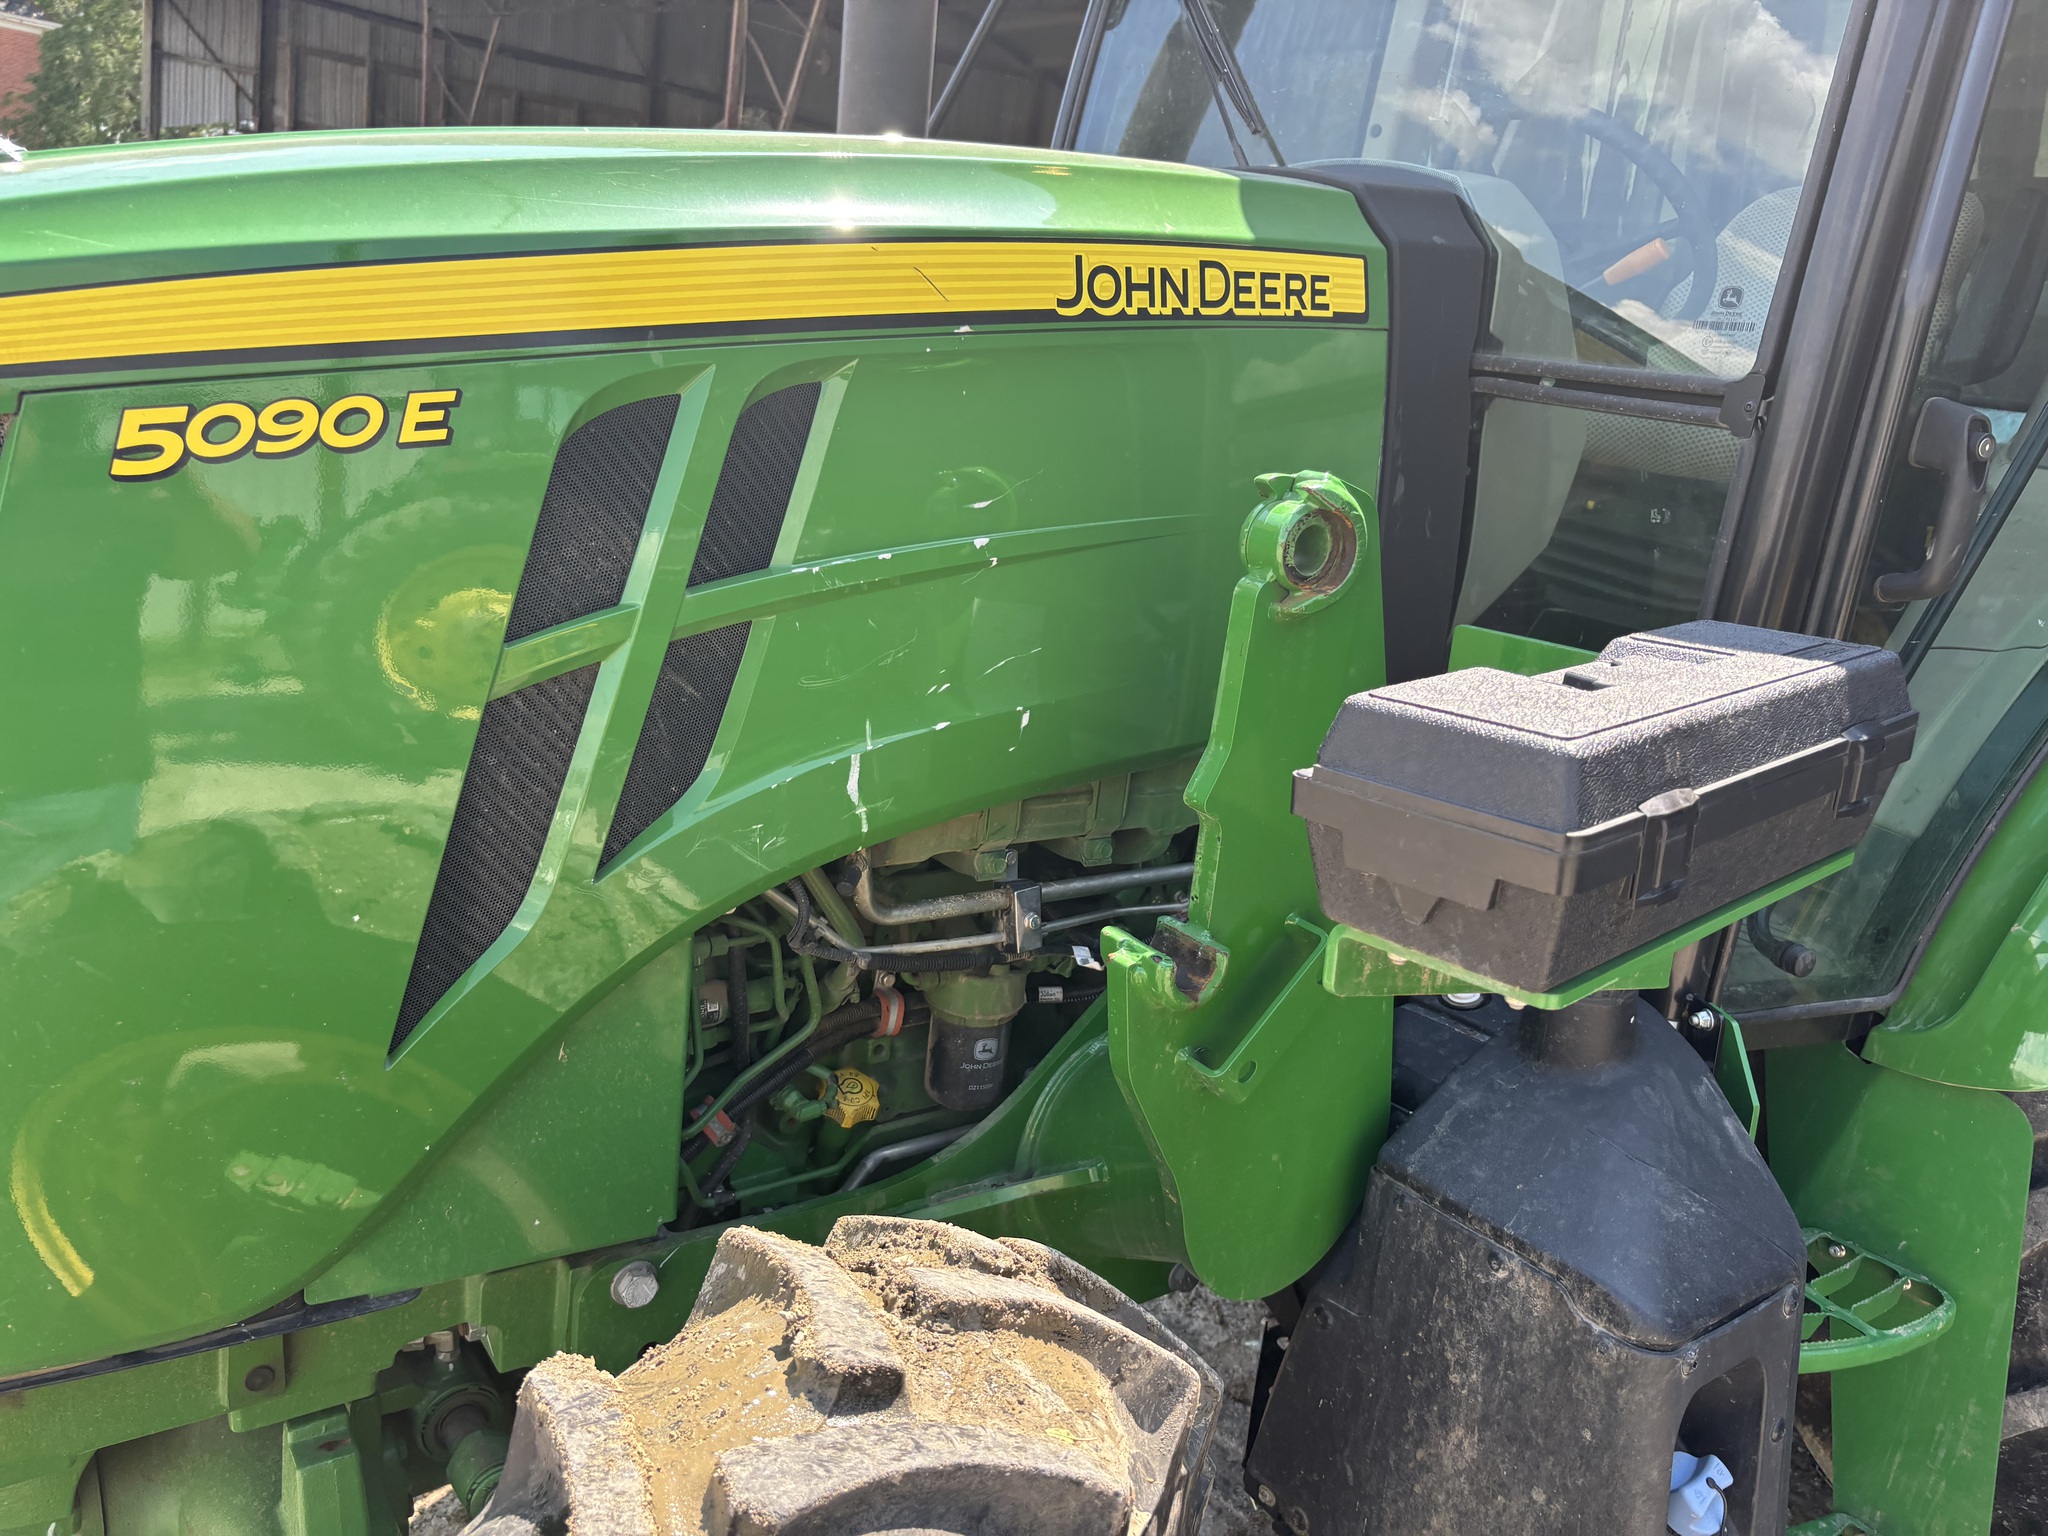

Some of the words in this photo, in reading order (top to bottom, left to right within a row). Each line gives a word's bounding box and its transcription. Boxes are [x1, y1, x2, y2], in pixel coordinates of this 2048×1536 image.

[1056, 253, 1192, 315] JOHN
[1198, 258, 1332, 315] DEERE
[108, 394, 390, 482] 5090
[397, 388, 463, 449] E
[960, 1062, 982, 1070] JOHN
